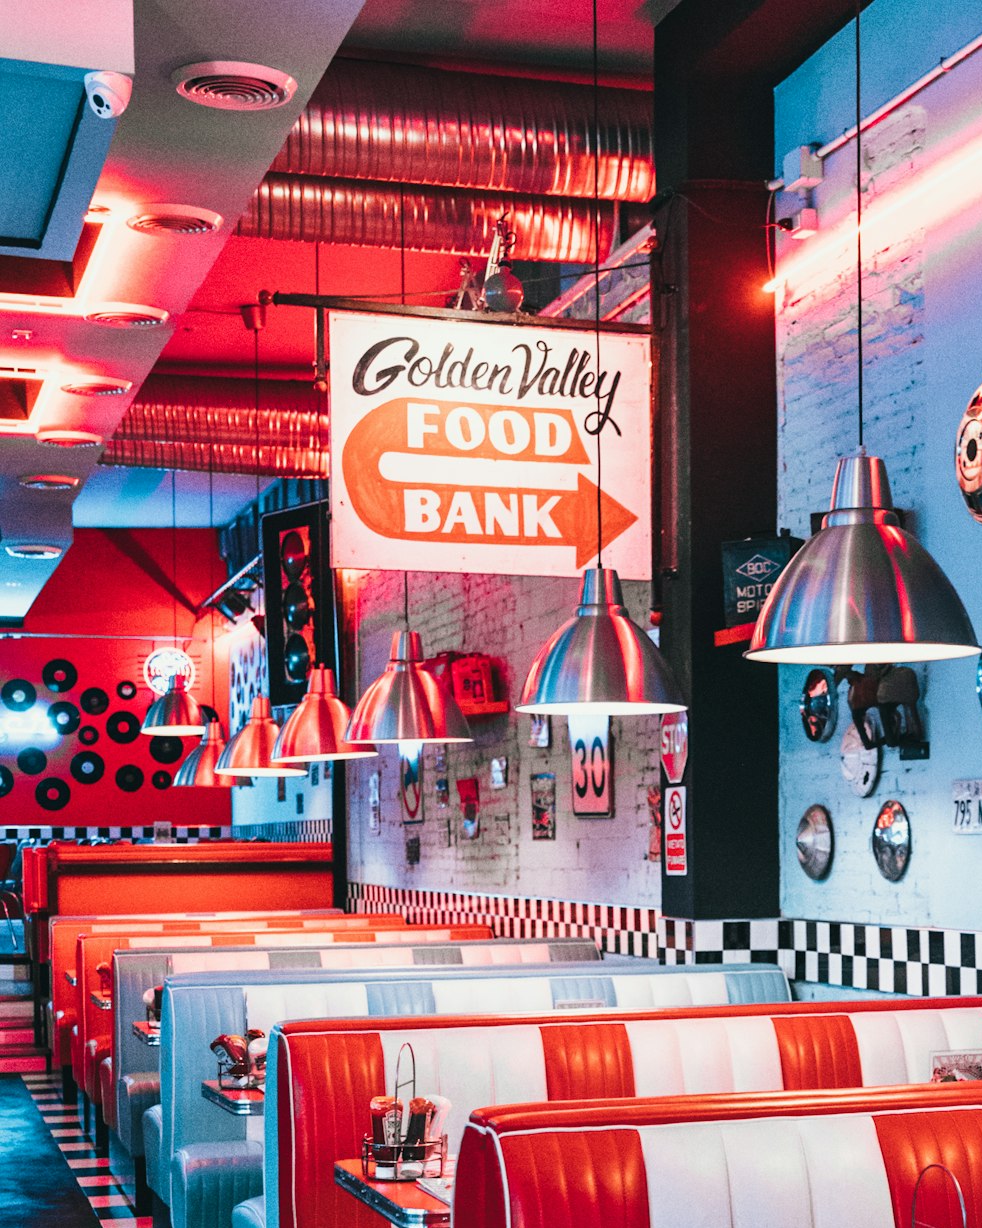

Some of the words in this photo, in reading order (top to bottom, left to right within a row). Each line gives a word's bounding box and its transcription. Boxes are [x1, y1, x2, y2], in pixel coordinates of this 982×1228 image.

[352, 337, 513, 396] Golden
[512, 341, 622, 437] Valley
[407, 402, 572, 456] FOOD
[404, 489, 563, 538] BANK
[736, 584, 775, 598] MOTO
[575, 736, 606, 798] 30
[954, 799, 972, 826] 795
